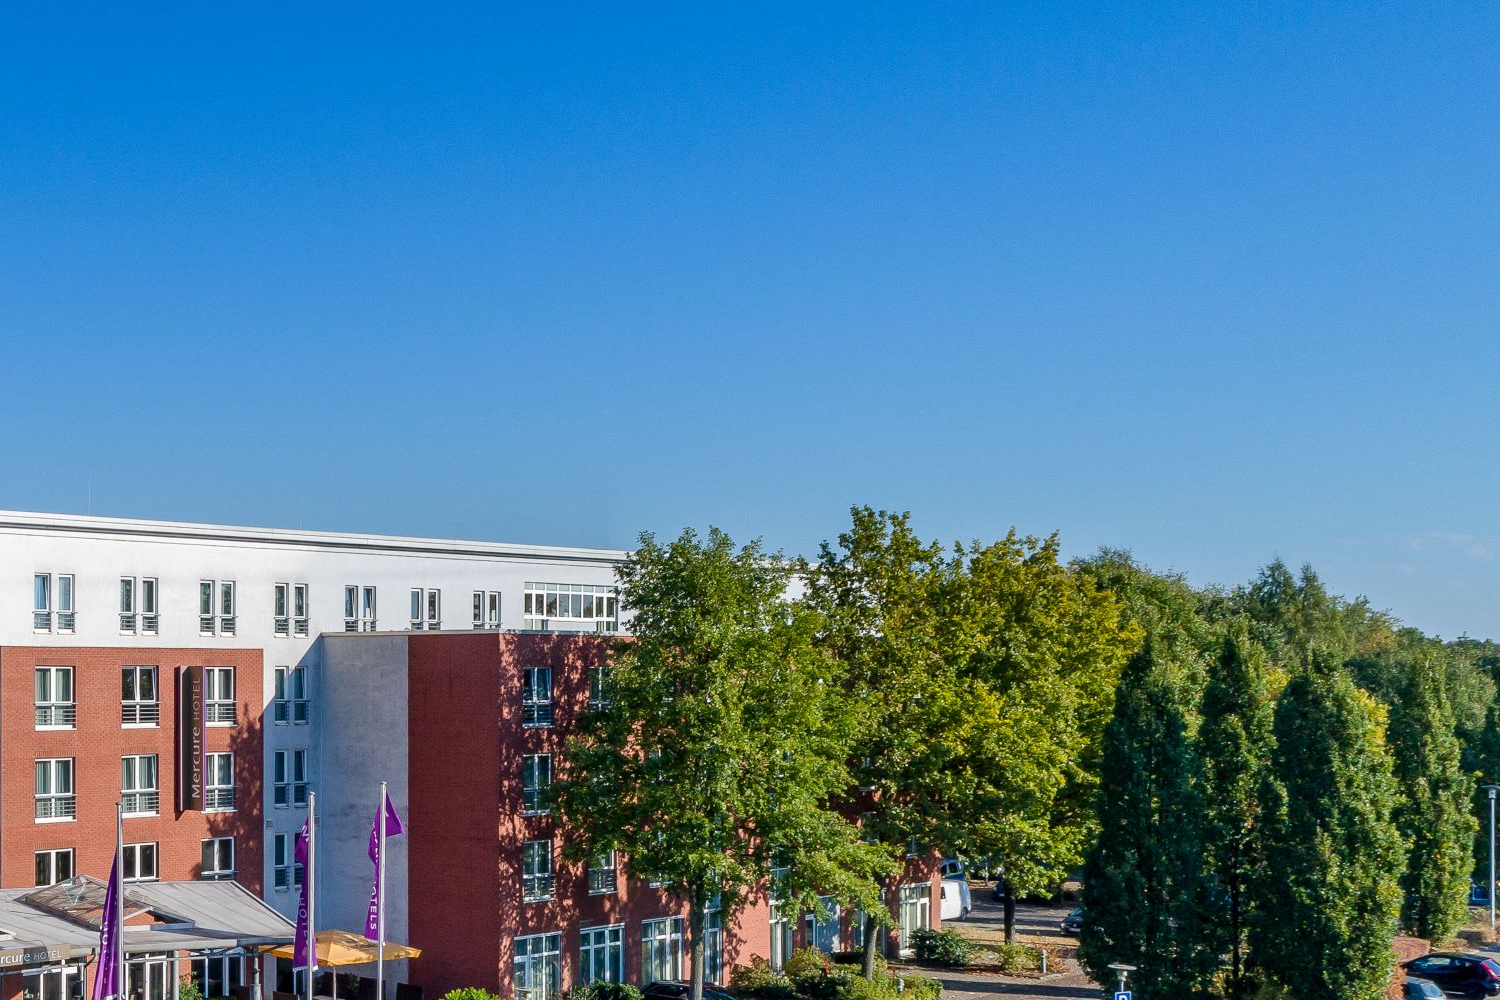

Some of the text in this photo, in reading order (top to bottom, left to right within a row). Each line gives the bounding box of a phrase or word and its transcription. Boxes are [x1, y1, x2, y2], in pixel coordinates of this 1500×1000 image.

[191, 678, 201, 799] Mercure HOTEL
[33, 949, 62, 960] HOTEL
